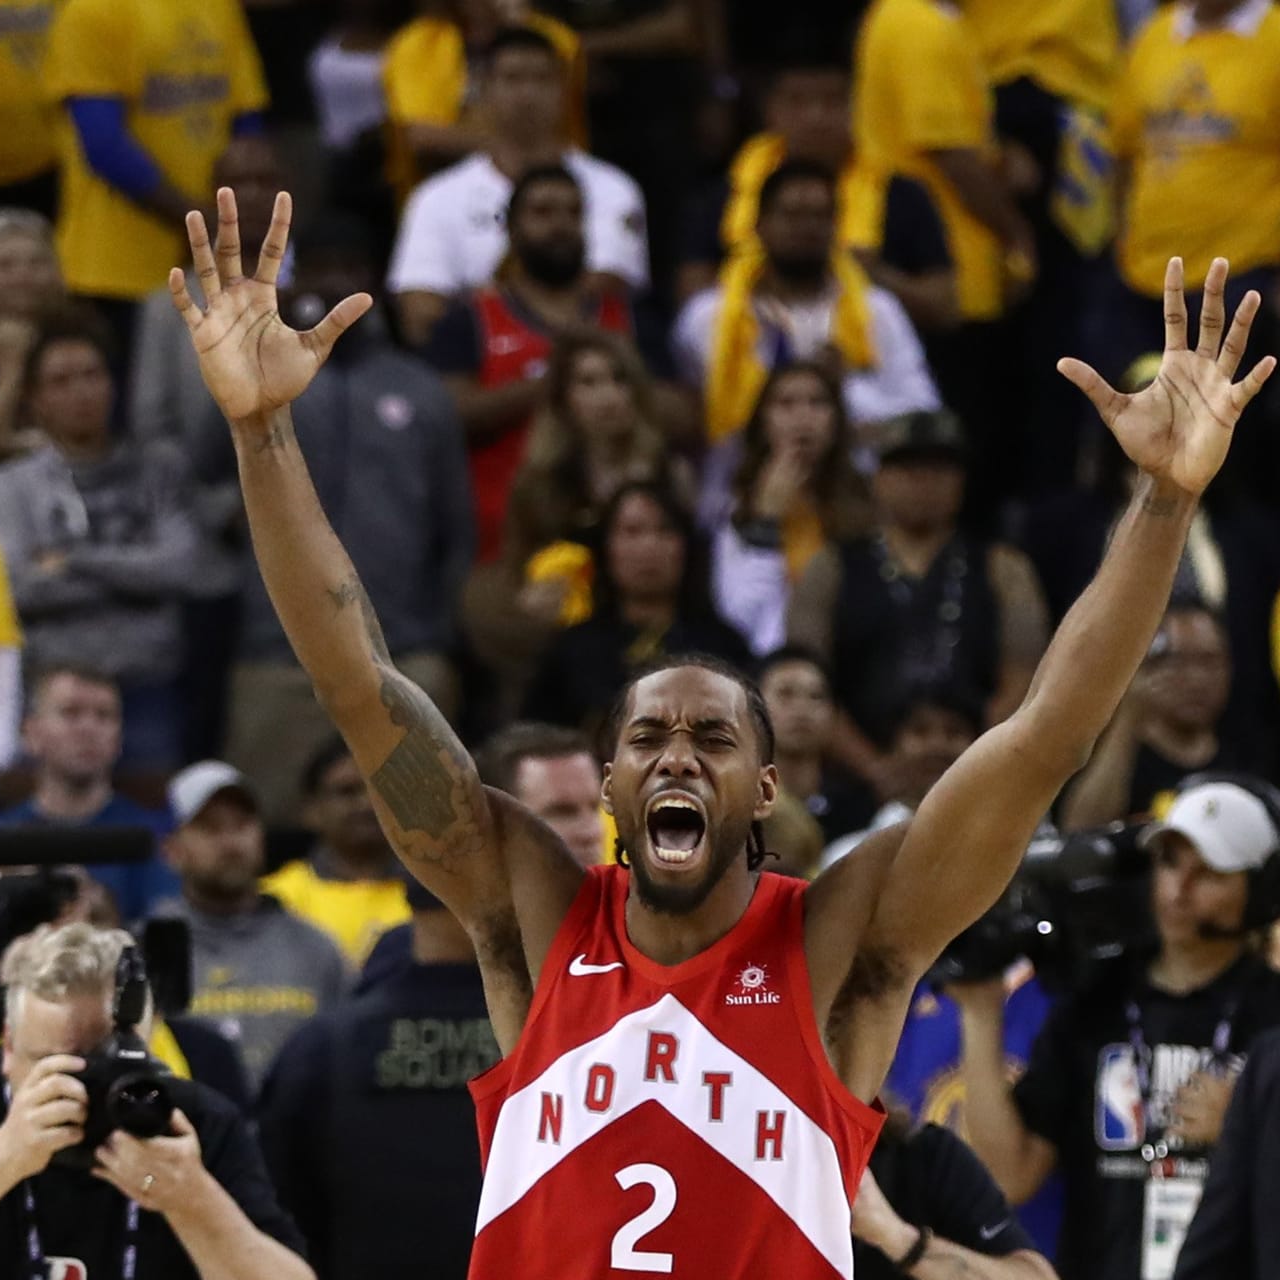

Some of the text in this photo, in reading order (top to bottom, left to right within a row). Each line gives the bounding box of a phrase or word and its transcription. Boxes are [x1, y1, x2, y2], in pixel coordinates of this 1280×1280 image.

[725, 991, 780, 1005] Sun Life
[376, 1048, 501, 1088] SQUA
[537, 1030, 786, 1162] NORTH
[610, 1163, 677, 1273] 2
